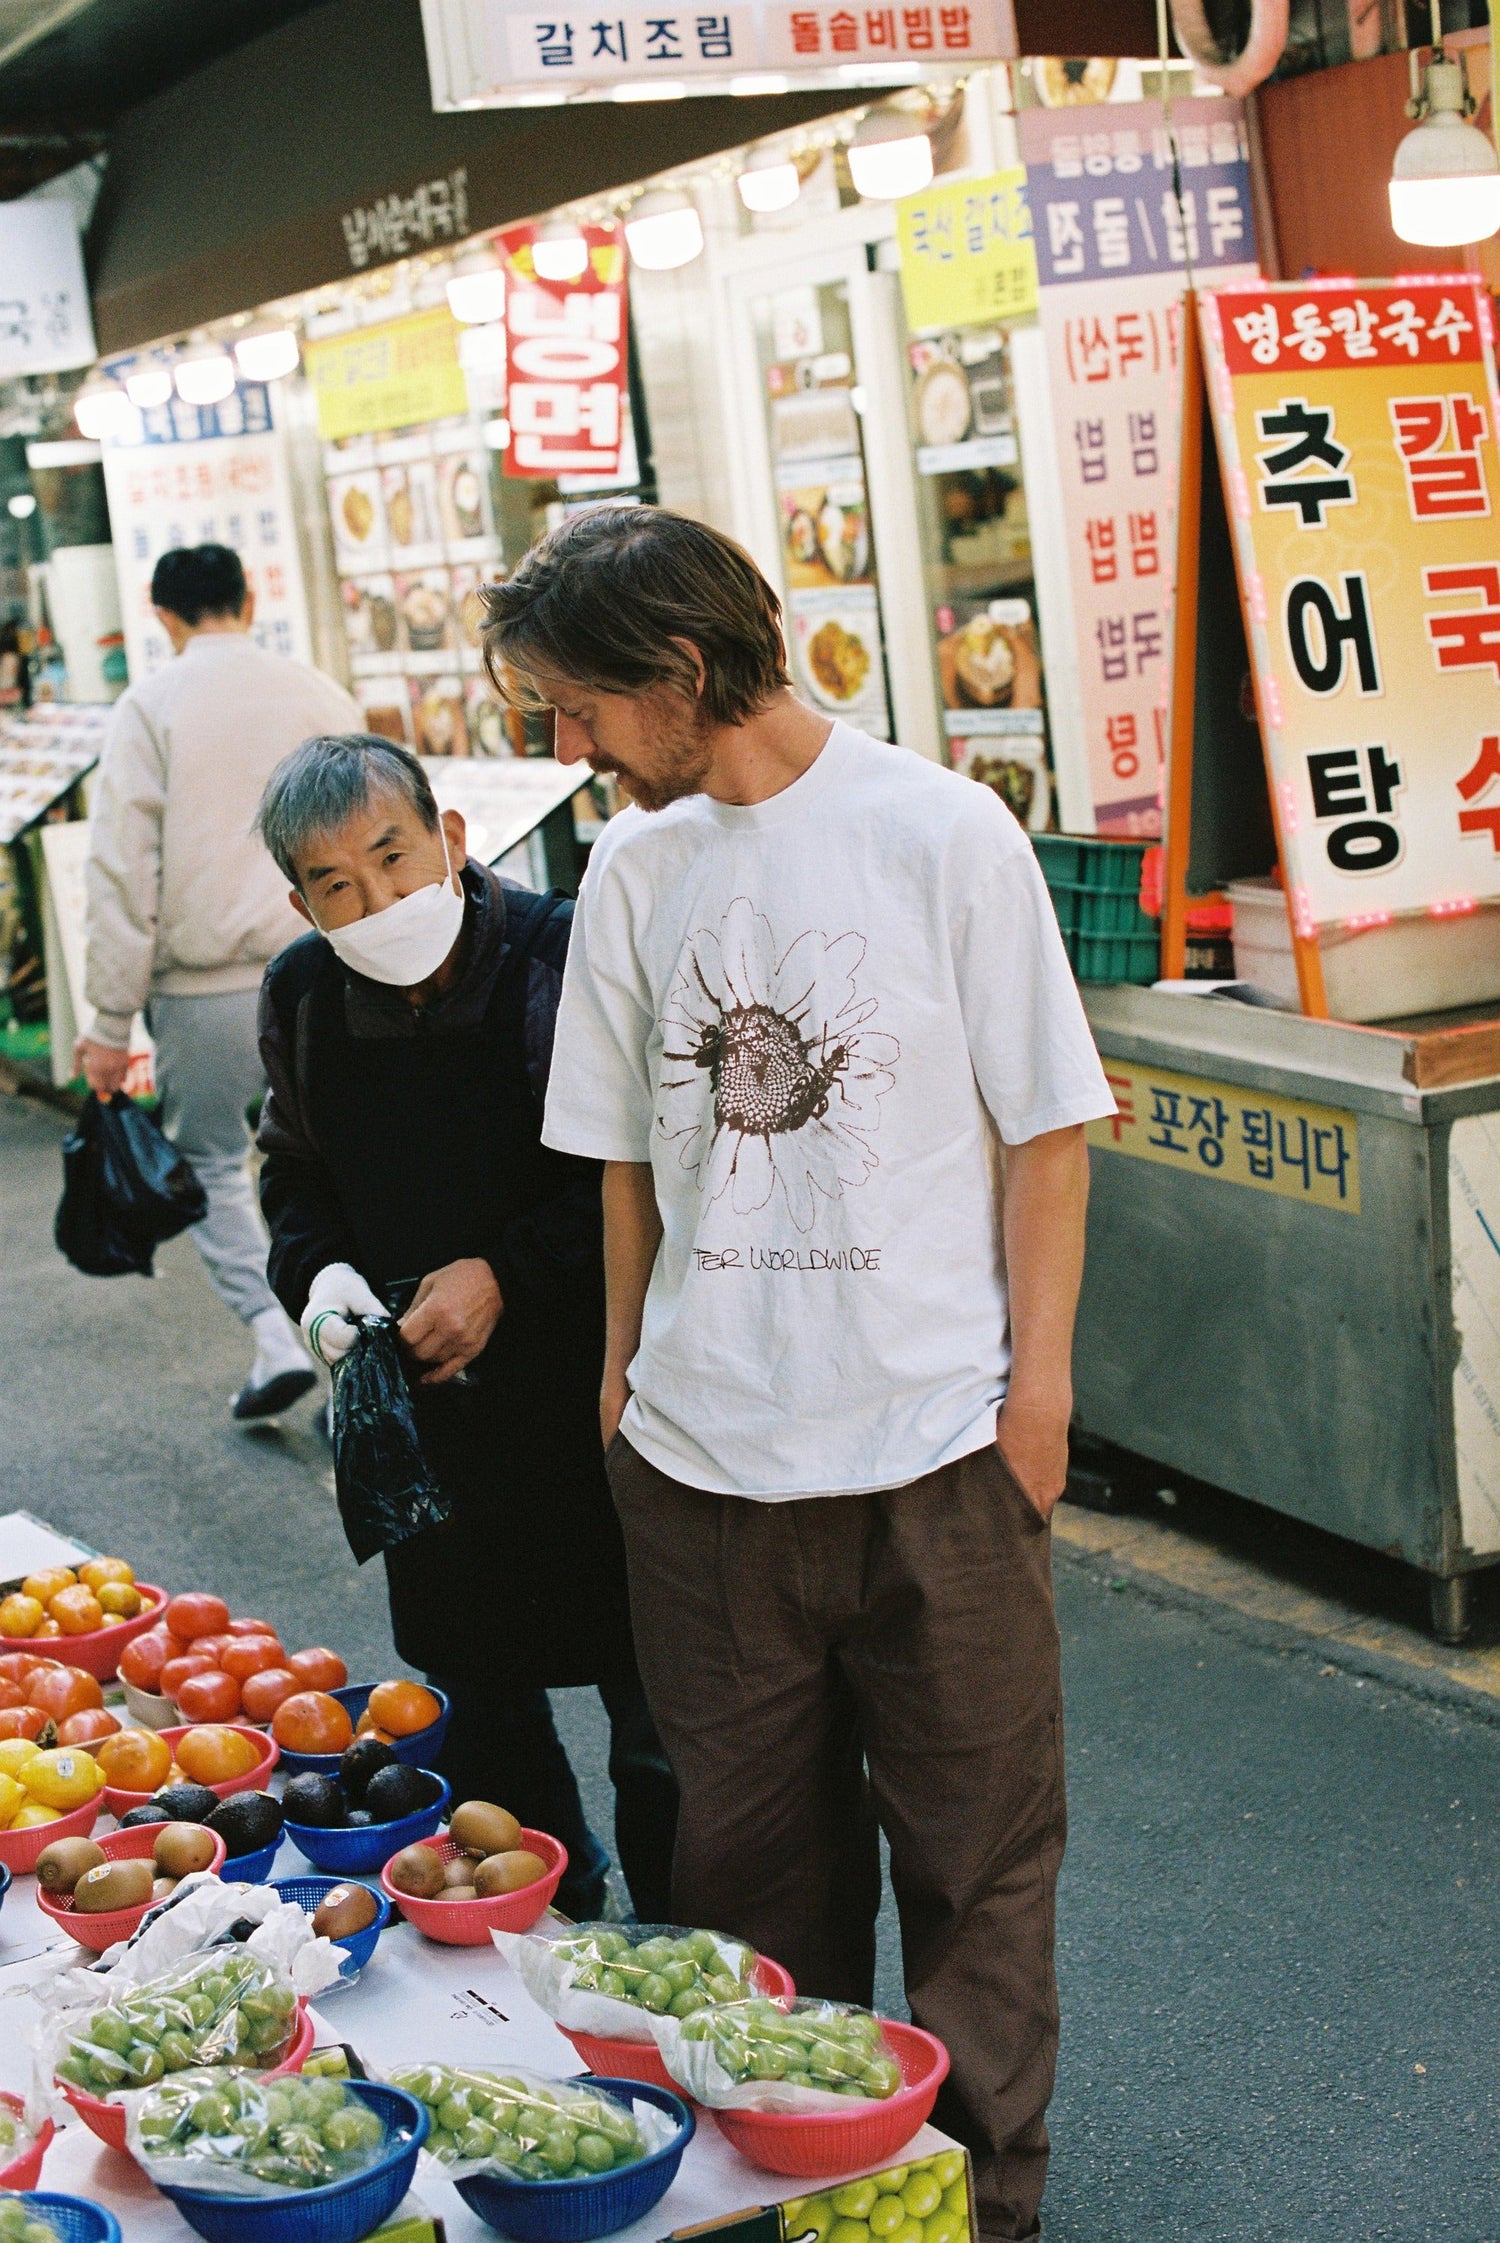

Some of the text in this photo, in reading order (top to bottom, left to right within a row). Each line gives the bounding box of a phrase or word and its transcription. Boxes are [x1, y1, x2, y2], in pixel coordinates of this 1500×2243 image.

[535, 6, 973, 66] 갈치조림 돌솥비빔밥
[508, 290, 620, 469] 냉면
[1233, 298, 1474, 365] 명동칼국수
[1259, 401, 1402, 873] 추어탕
[1149, 1086, 1230, 1168] 포장
[1242, 1108, 1351, 1199] 됩니다
